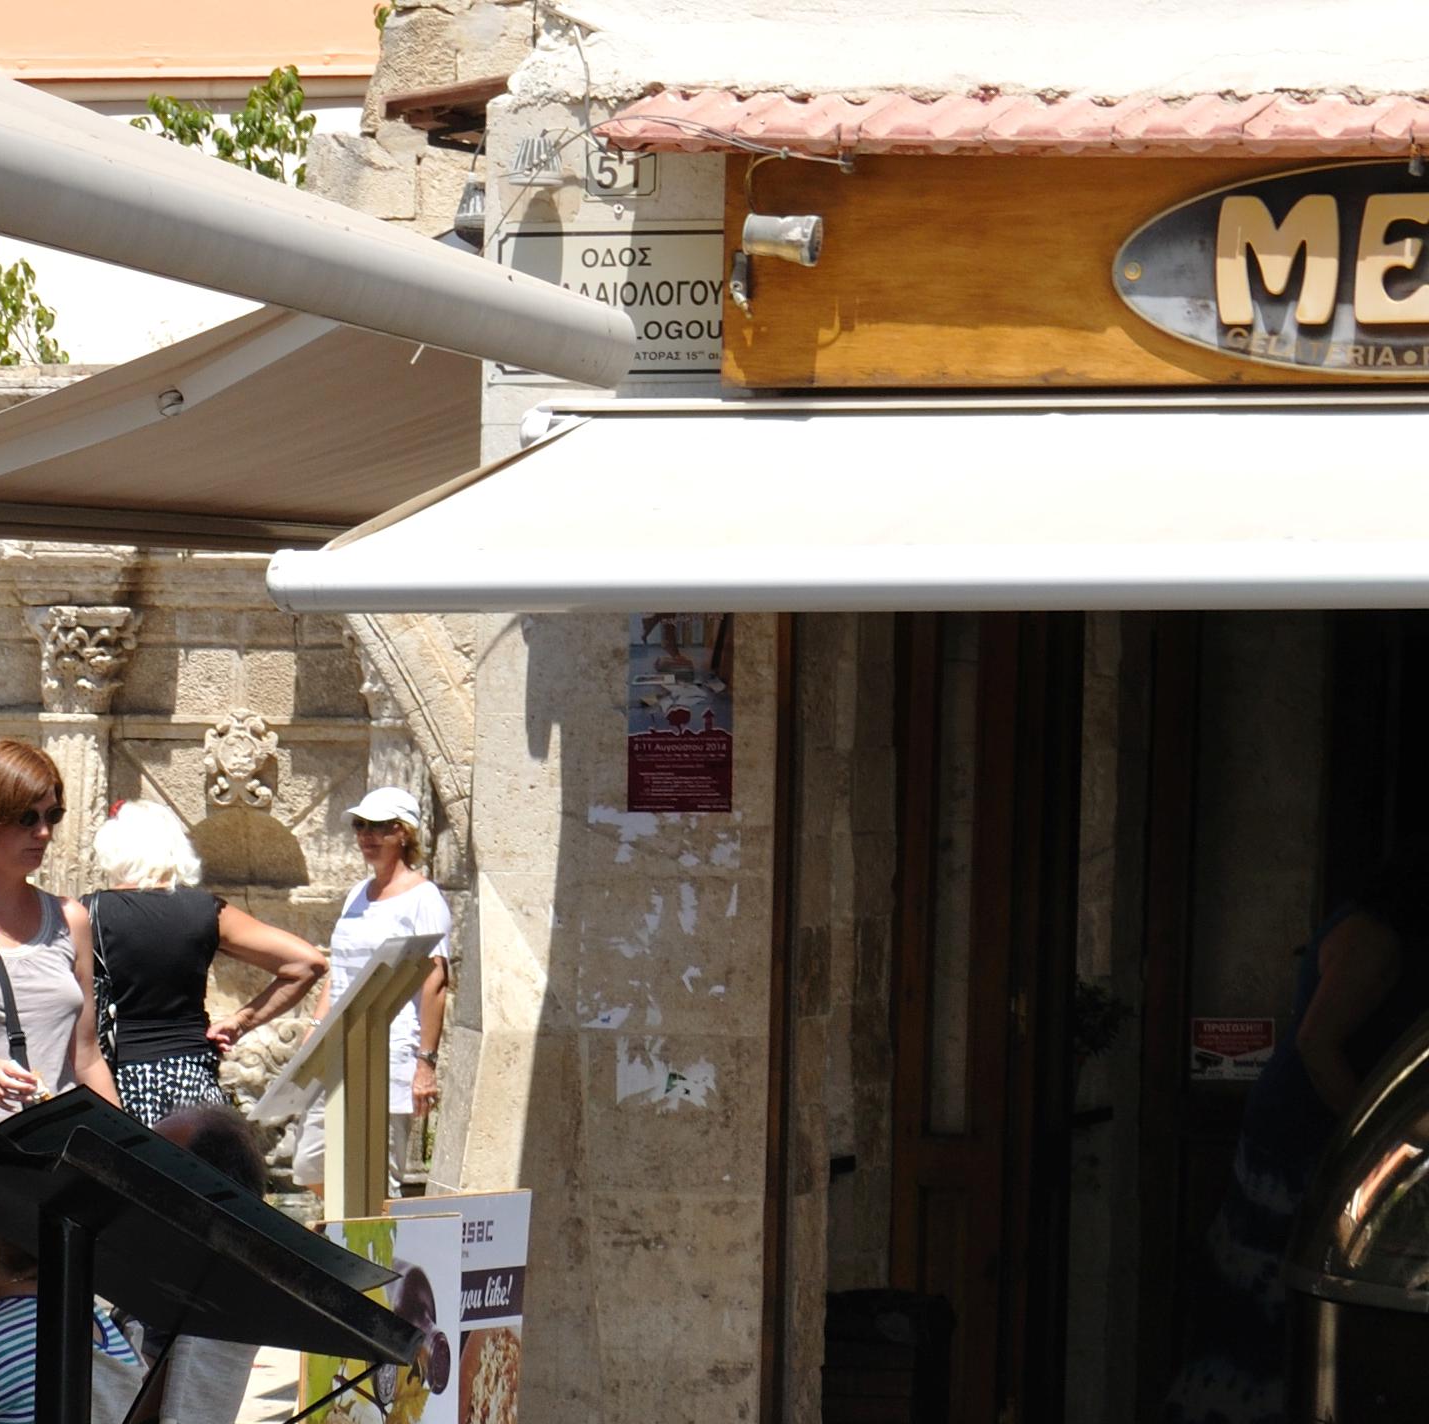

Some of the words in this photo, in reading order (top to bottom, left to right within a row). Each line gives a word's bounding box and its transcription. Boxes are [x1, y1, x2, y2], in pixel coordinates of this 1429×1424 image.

[596, 156, 639, 189] 51
[582, 247, 652, 267] ΟΔΟΣ
[563, 280, 724, 306] ΛΑΙΟΛΟΓΟΥ
[634, 351, 681, 361] ΑΤΟΡΑΣ
[1226, 328, 1397, 367] GELATERIA
[460, 1288, 482, 1318] you
[484, 1273, 513, 1307] like!
